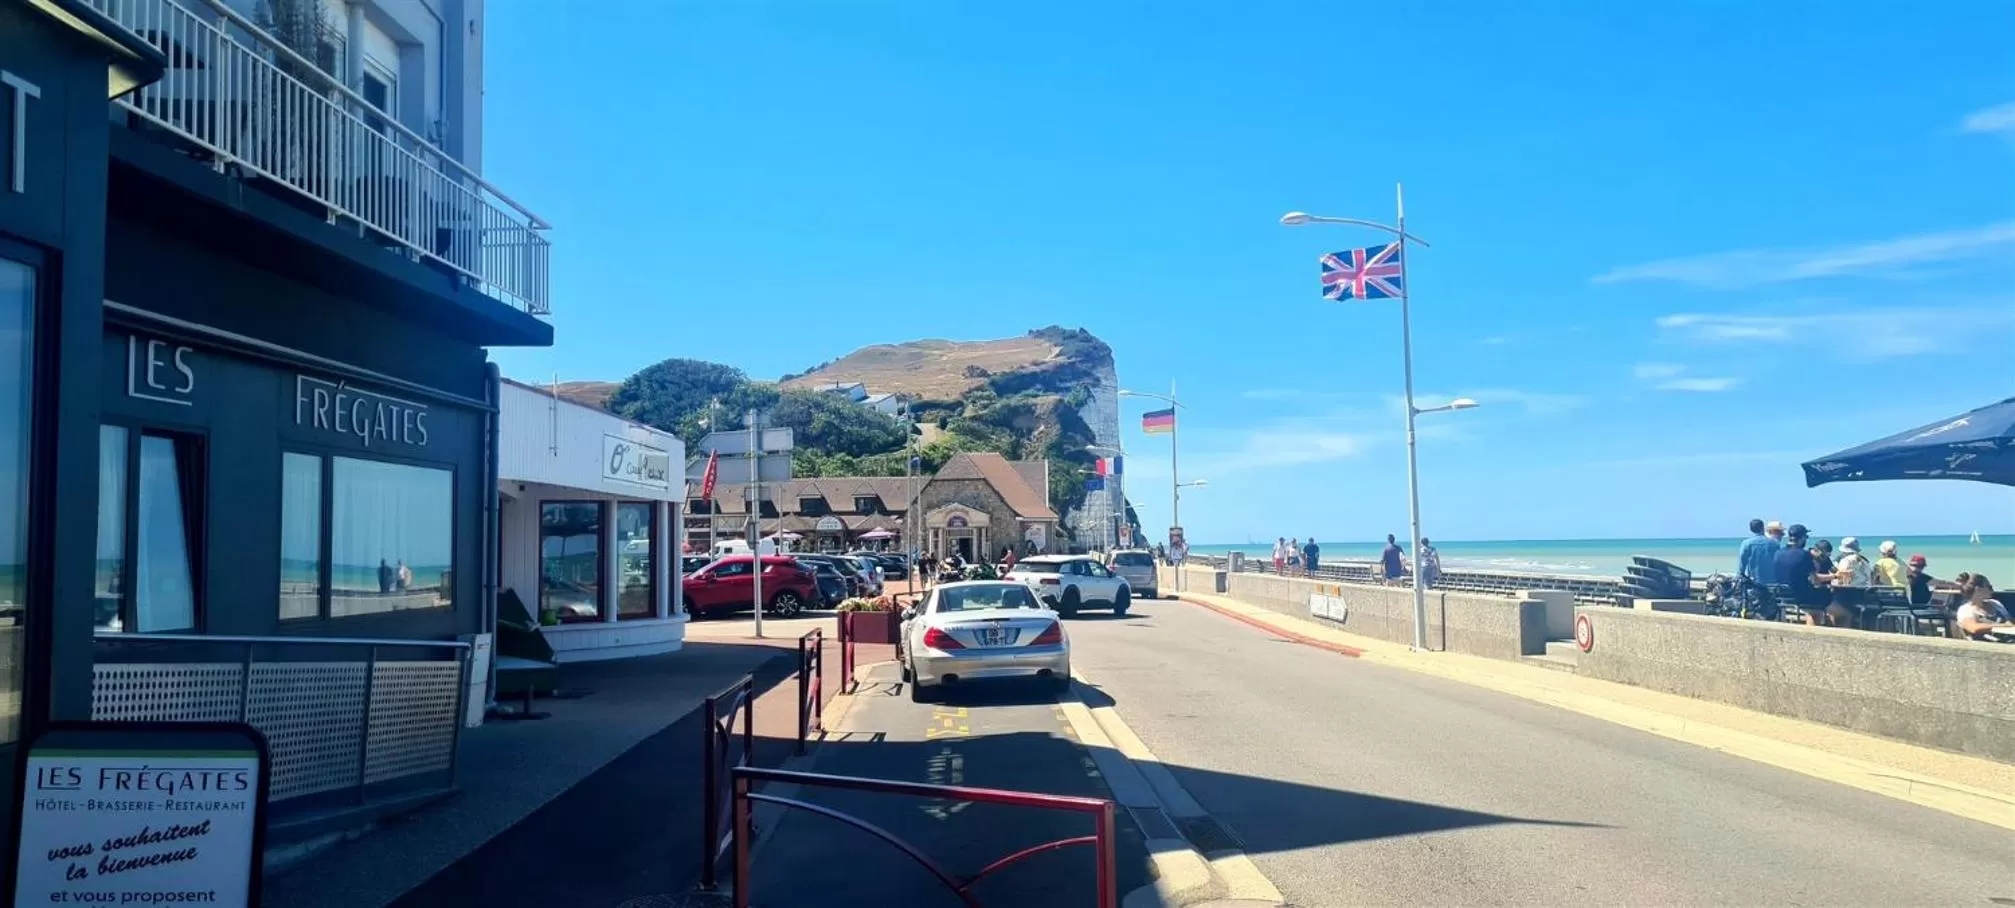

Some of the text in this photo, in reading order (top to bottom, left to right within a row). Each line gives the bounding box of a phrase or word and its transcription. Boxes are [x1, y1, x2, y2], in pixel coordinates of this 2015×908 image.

[128, 335, 428, 446] LES FRÉGATES
[37, 765, 248, 795] LES FRÉGATES
[47, 819, 211, 861] vous souhaitent
[66, 846, 198, 881] la bienvenue
[50, 889, 216, 905] et vous proposent
